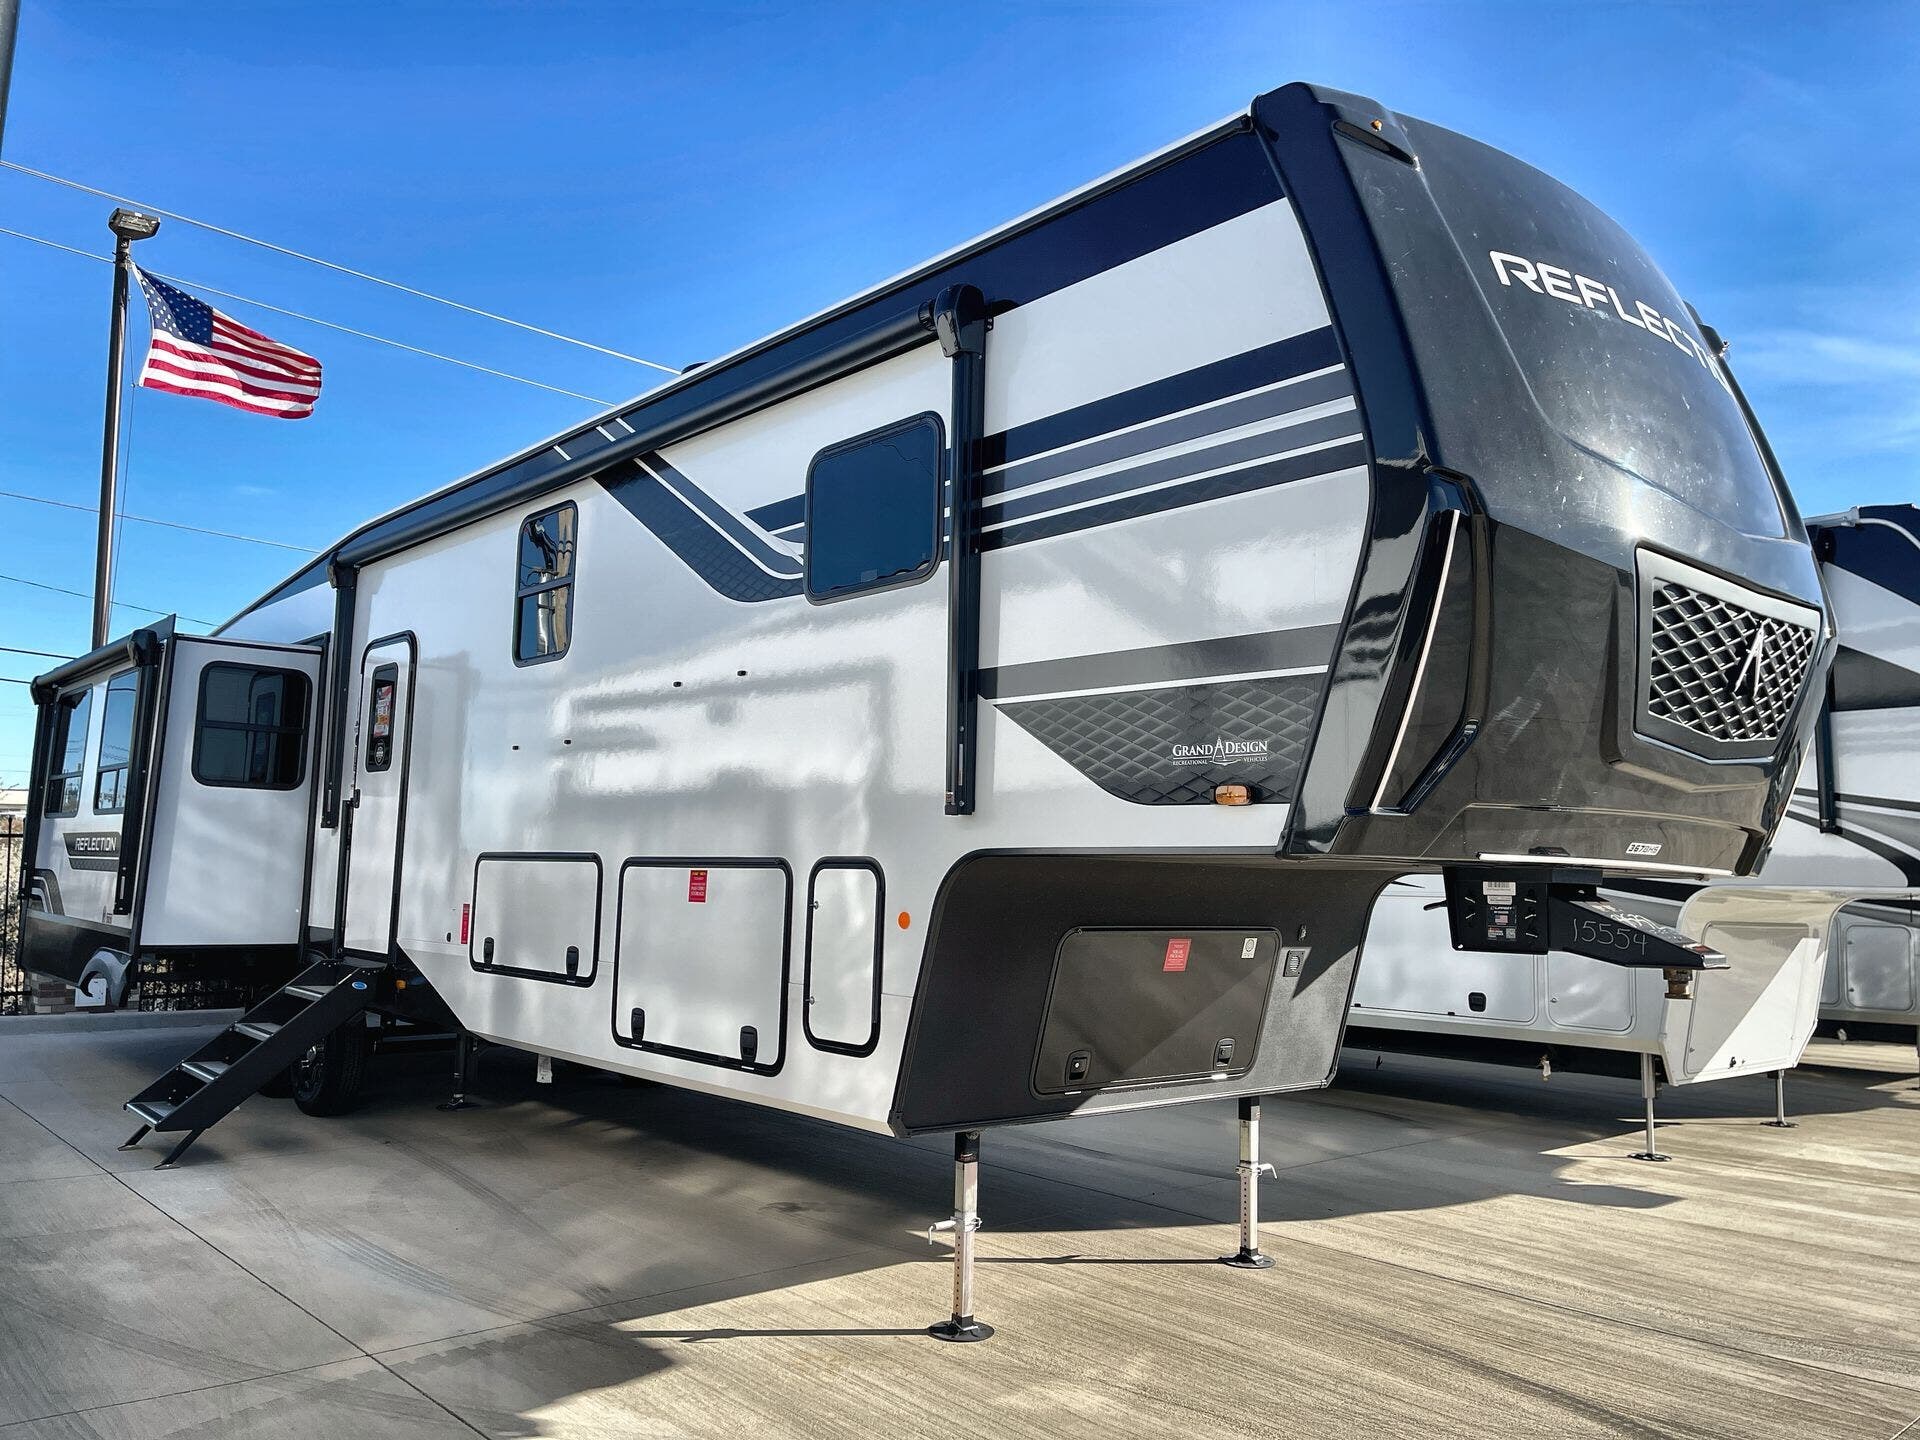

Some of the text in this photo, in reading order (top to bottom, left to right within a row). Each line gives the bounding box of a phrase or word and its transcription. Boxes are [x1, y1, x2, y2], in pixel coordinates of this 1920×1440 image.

[1489, 250, 1736, 397] REFLECTIO
[1172, 740, 1268, 757] GRAND DESIGN
[75, 837, 117, 851] REFLECTION
[1573, 918, 1648, 956] 15554
